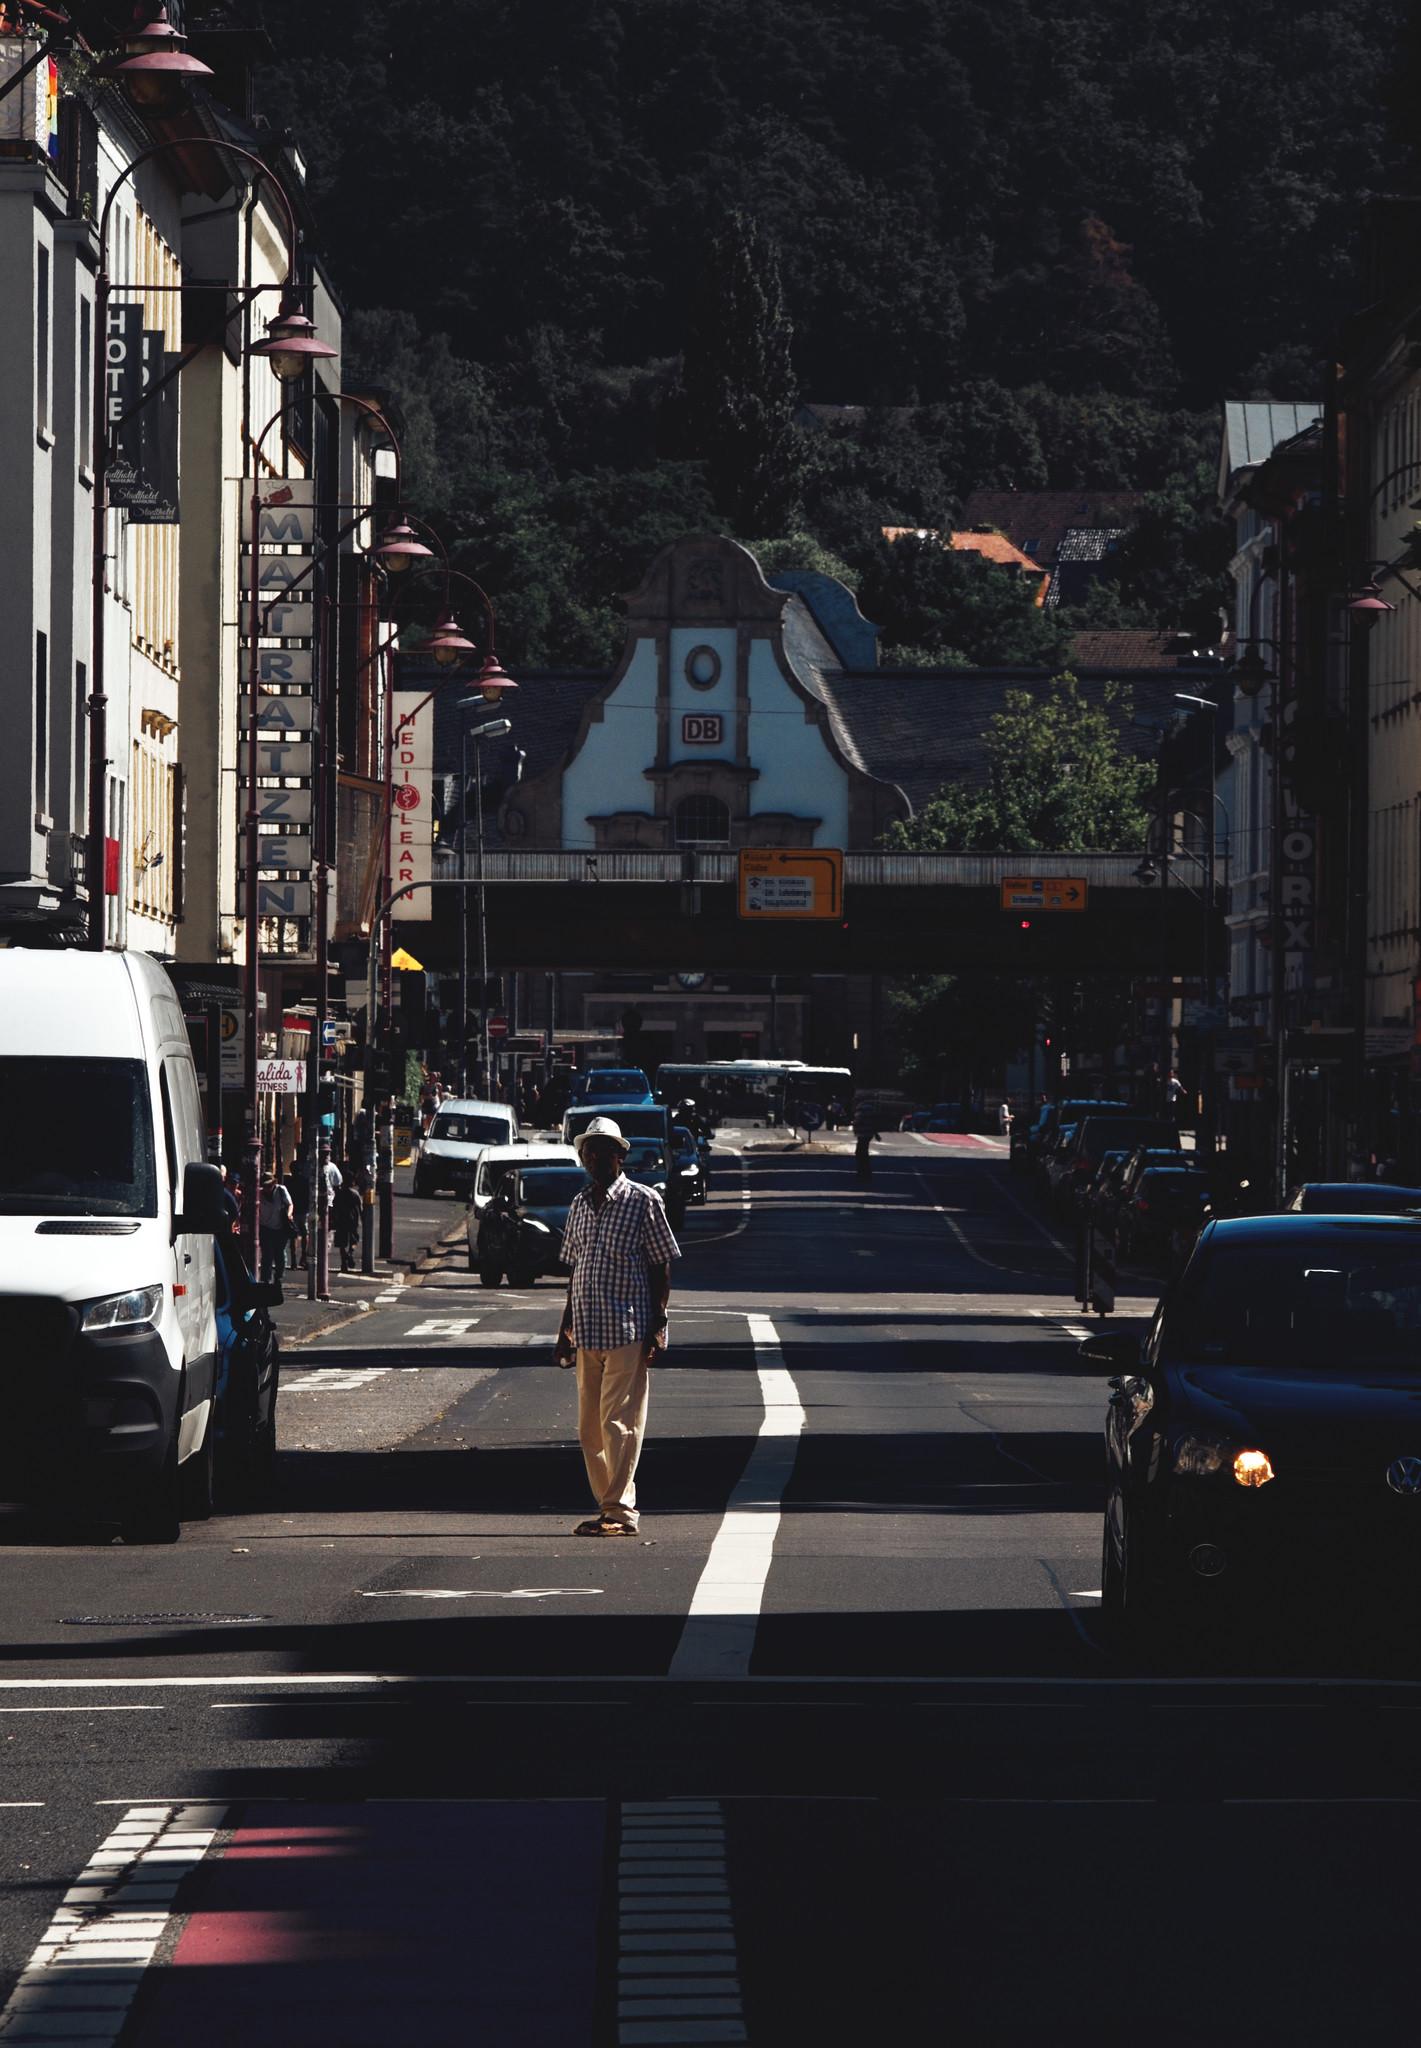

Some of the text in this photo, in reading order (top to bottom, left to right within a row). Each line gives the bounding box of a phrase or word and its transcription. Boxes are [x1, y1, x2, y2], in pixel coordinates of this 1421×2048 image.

[257, 513, 303, 913] MATRATZEN
[687, 719, 717, 739] DB
[257, 1061, 292, 1080] alida
